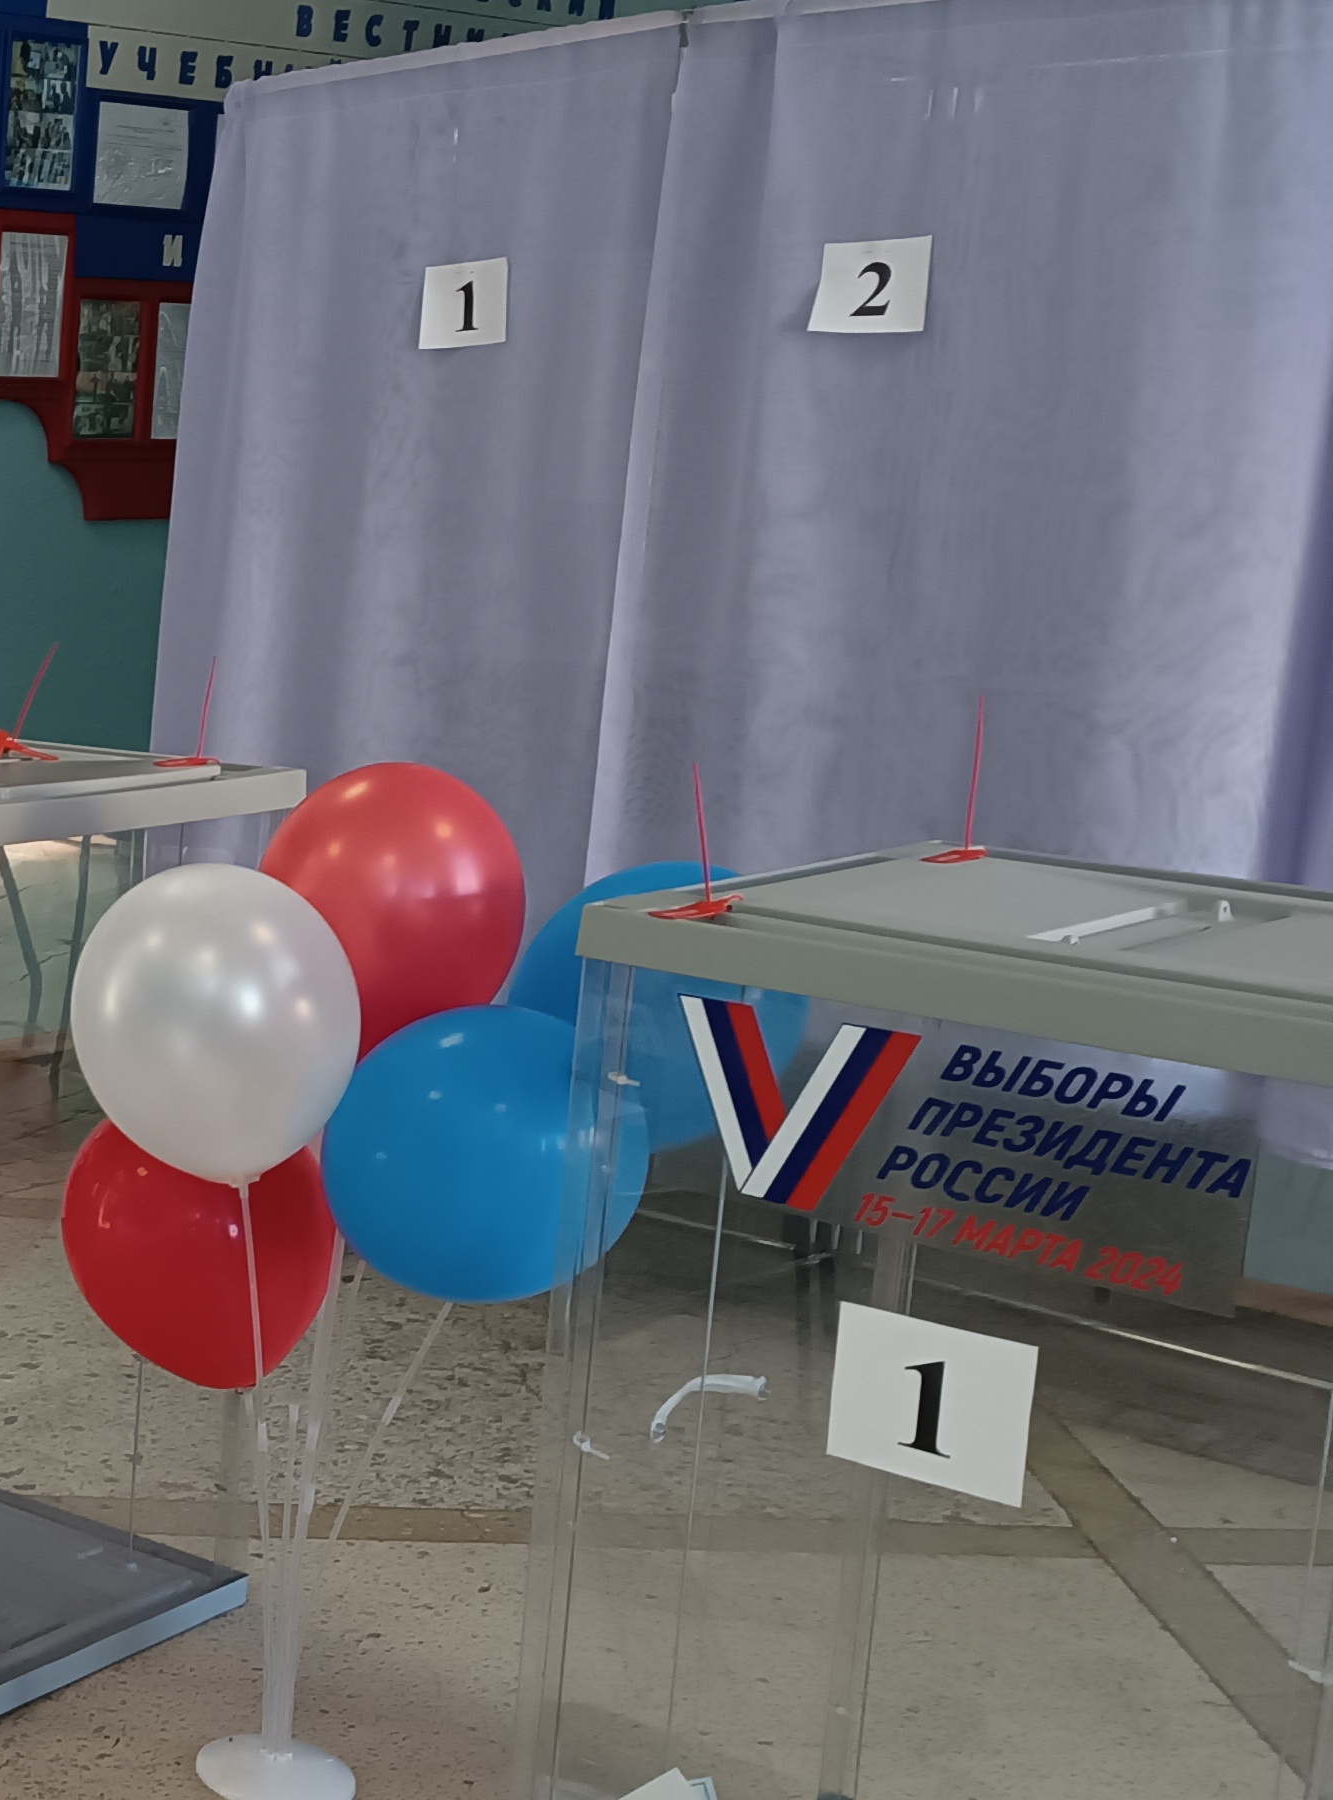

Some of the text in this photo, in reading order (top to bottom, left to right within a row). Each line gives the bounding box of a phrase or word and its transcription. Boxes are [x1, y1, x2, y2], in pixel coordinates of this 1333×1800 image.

[296, 4, 513, 51] ВЕСТН
[454, 280, 479, 332] 1
[849, 260, 893, 318] 2
[939, 1043, 1186, 1123] ВЫБОРЫ
[876, 1145, 1091, 1222] РОССИИ
[907, 1096, 1255, 1199] ПРЕЗИДЕНТА
[951, 1212, 1083, 1273] МАРТА
[1083, 1244, 1185, 1297] 2024
[896, 1360, 951, 1459] 1
